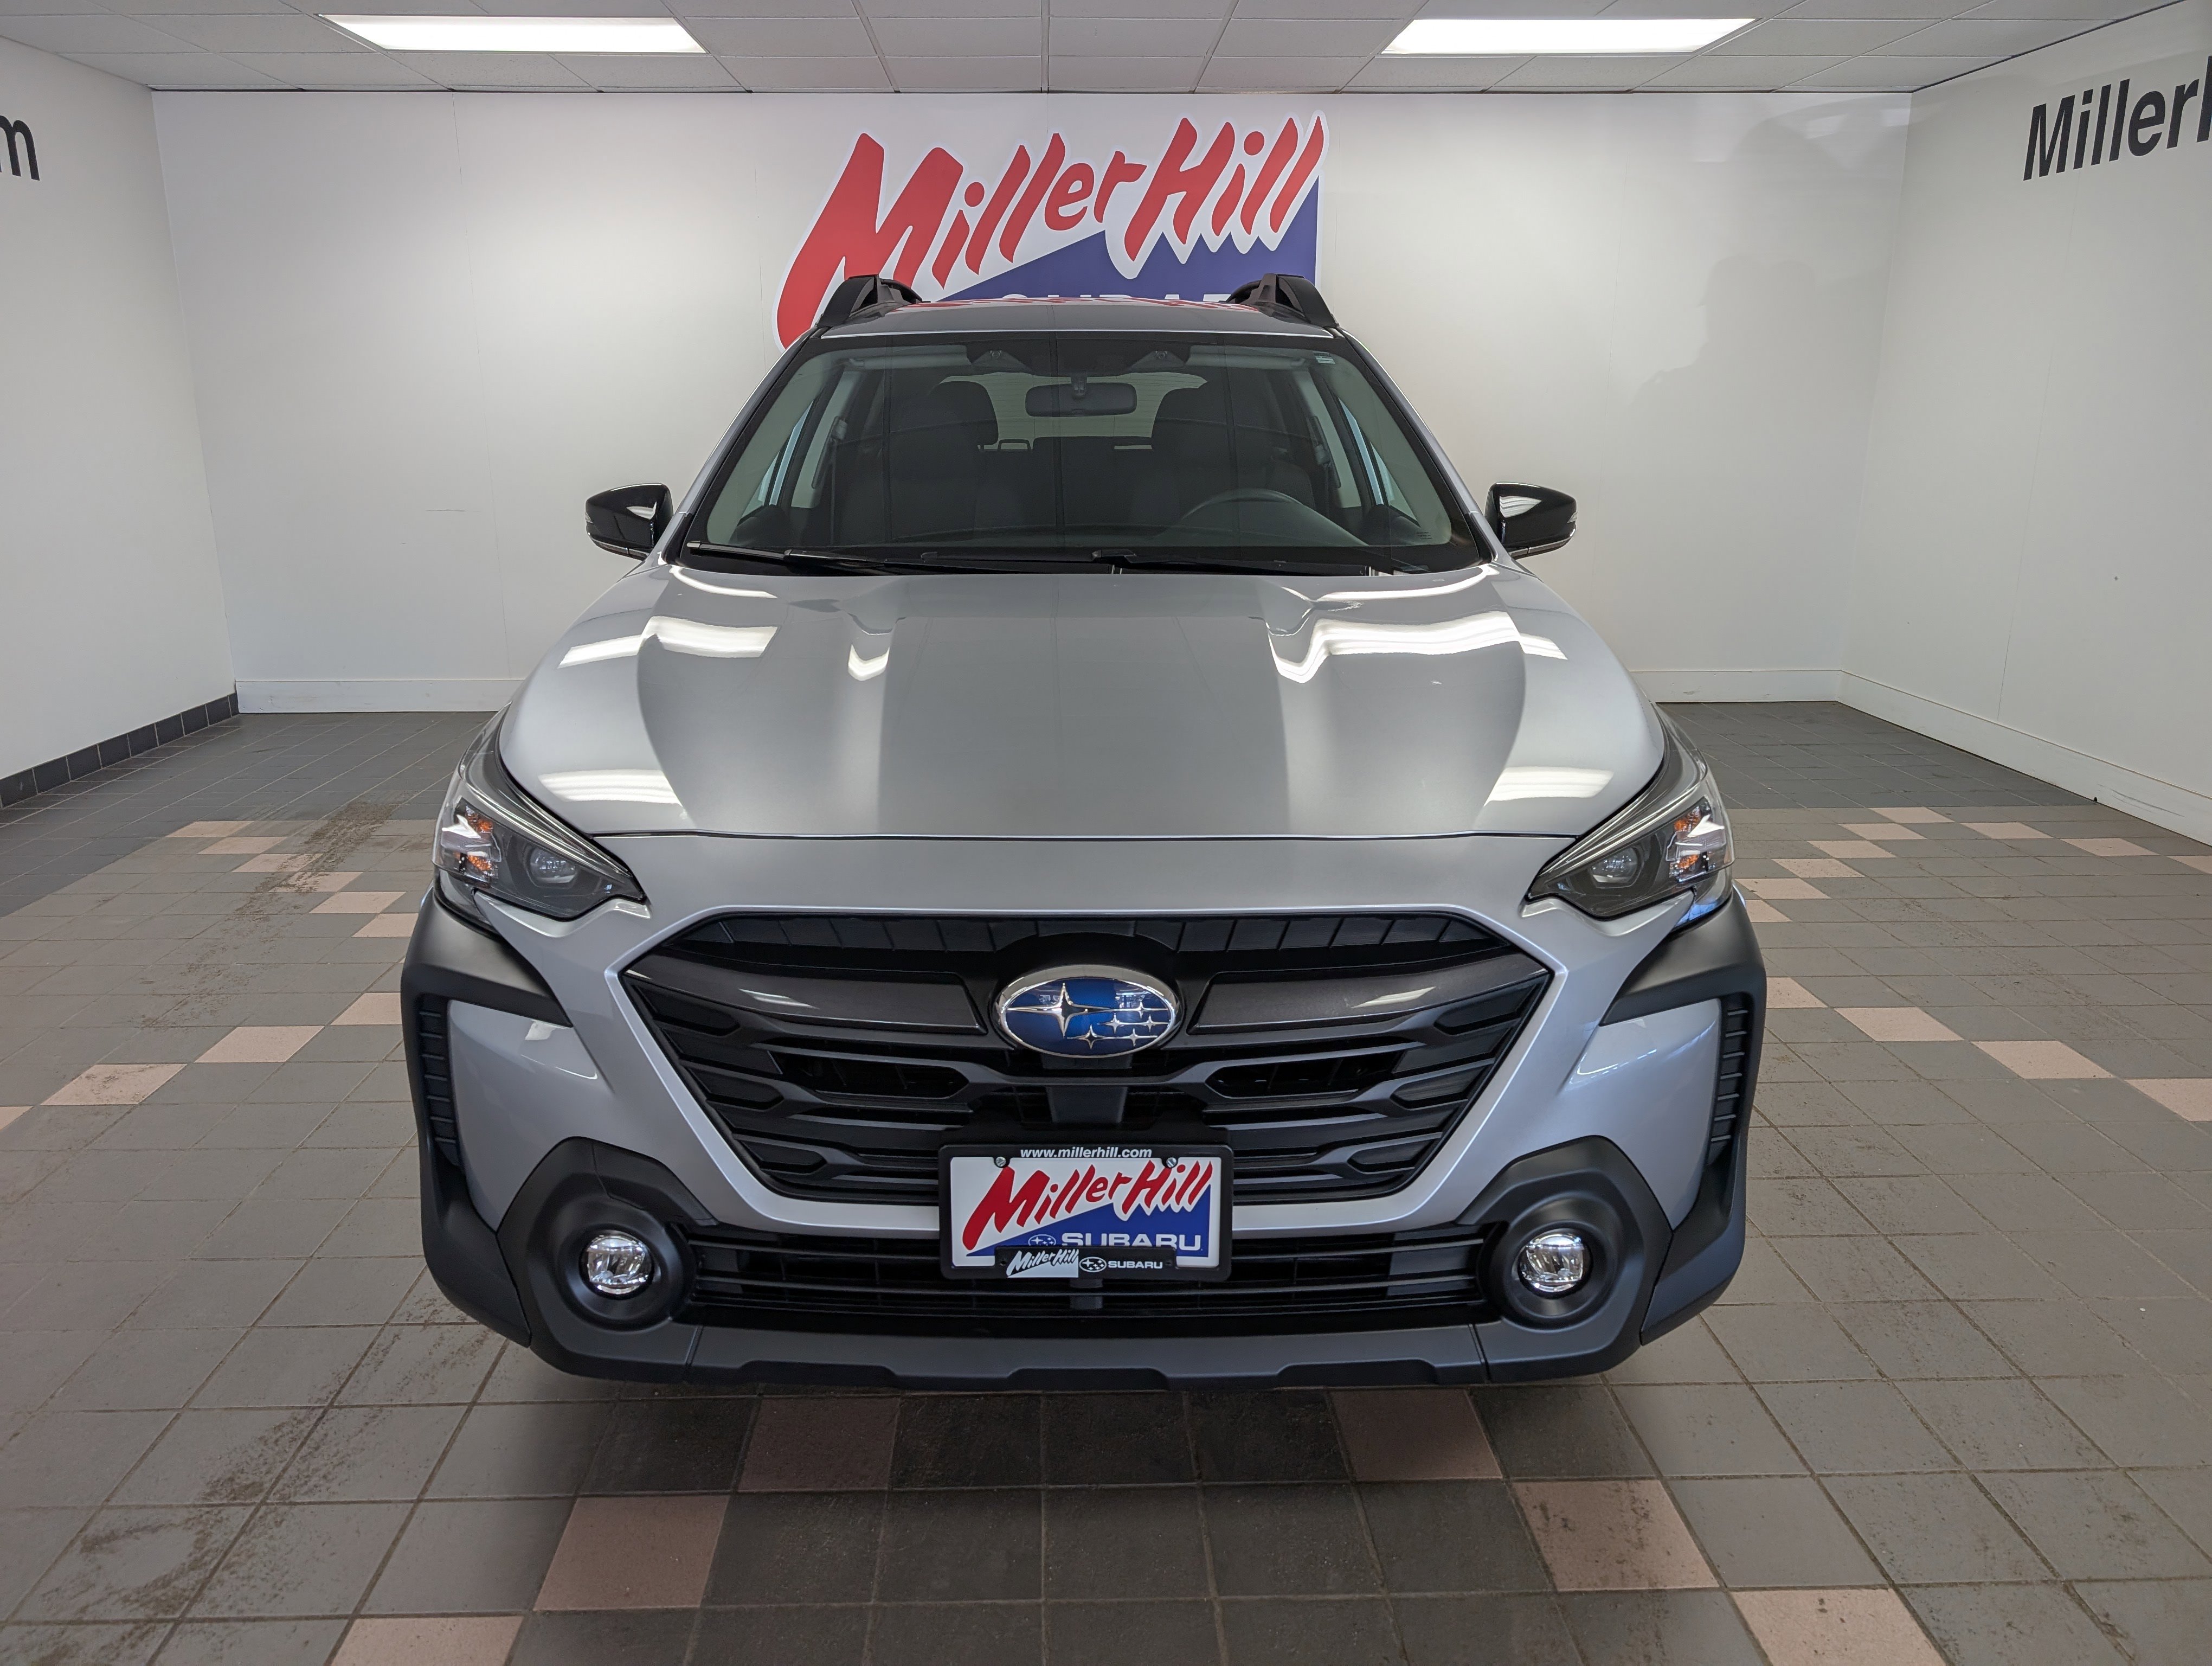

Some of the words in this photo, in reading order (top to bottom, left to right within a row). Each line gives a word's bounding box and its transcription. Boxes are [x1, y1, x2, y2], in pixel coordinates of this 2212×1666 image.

[1020, 1146, 1153, 1158] www.millerhill.com
[1061, 1233, 1202, 1251] SUBARU
[1108, 1260, 1163, 1270] SUBARU
